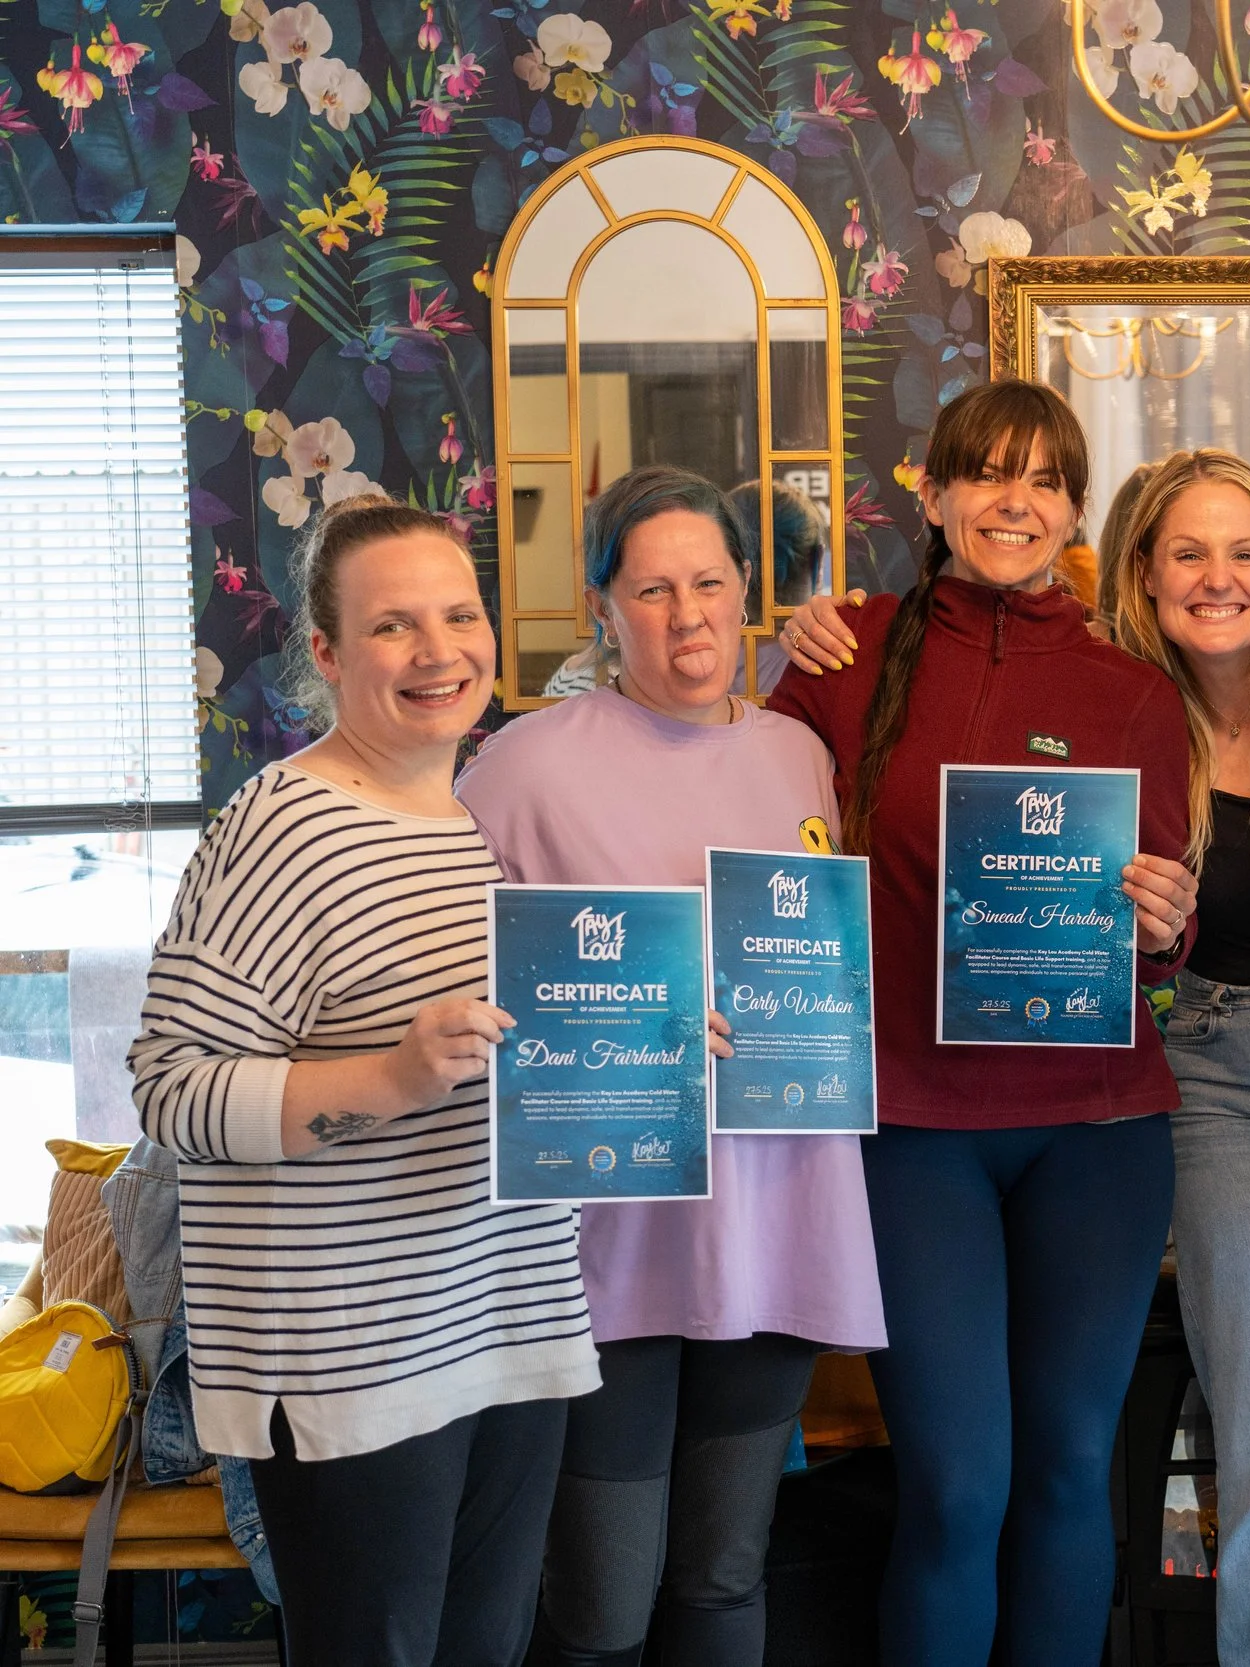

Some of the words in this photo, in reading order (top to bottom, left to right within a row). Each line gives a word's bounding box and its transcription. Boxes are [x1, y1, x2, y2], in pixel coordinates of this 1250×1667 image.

[981, 854, 1101, 872] CERTIFICATE
[962, 900, 1028, 926] Sinead
[1029, 903, 1115, 933] Harding
[742, 936, 840, 956] CERTIFICATE
[535, 983, 667, 1001] CERTIFICATE
[733, 984, 781, 1020] Carly
[784, 986, 854, 1015] Watson
[516, 1039, 576, 1067] Dani
[583, 1039, 686, 1070] Fairhurst
